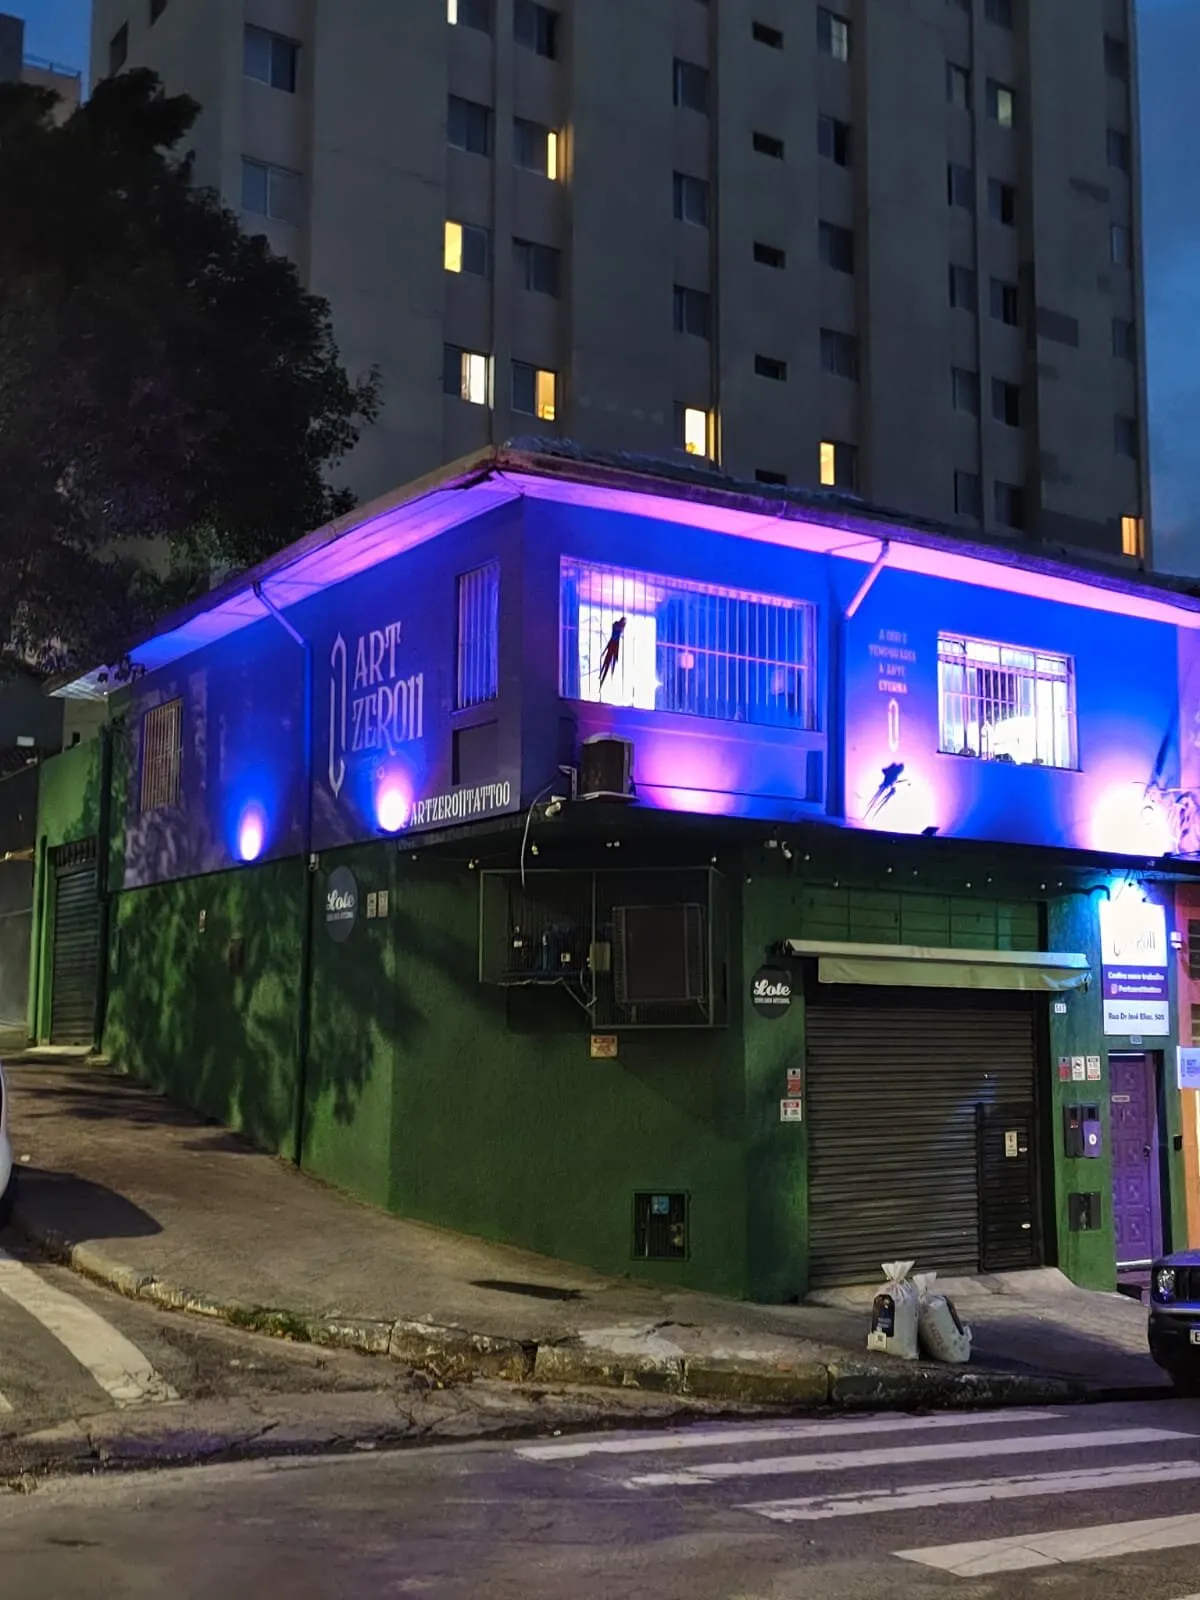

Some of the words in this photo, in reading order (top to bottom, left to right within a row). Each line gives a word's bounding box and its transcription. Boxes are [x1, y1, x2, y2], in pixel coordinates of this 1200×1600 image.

[353, 621, 402, 691] ART
[351, 672, 424, 756] ZERO11
[402, 781, 511, 829] ARTZERO11TATTOO
[1108, 1012, 1119, 1020] Rua
